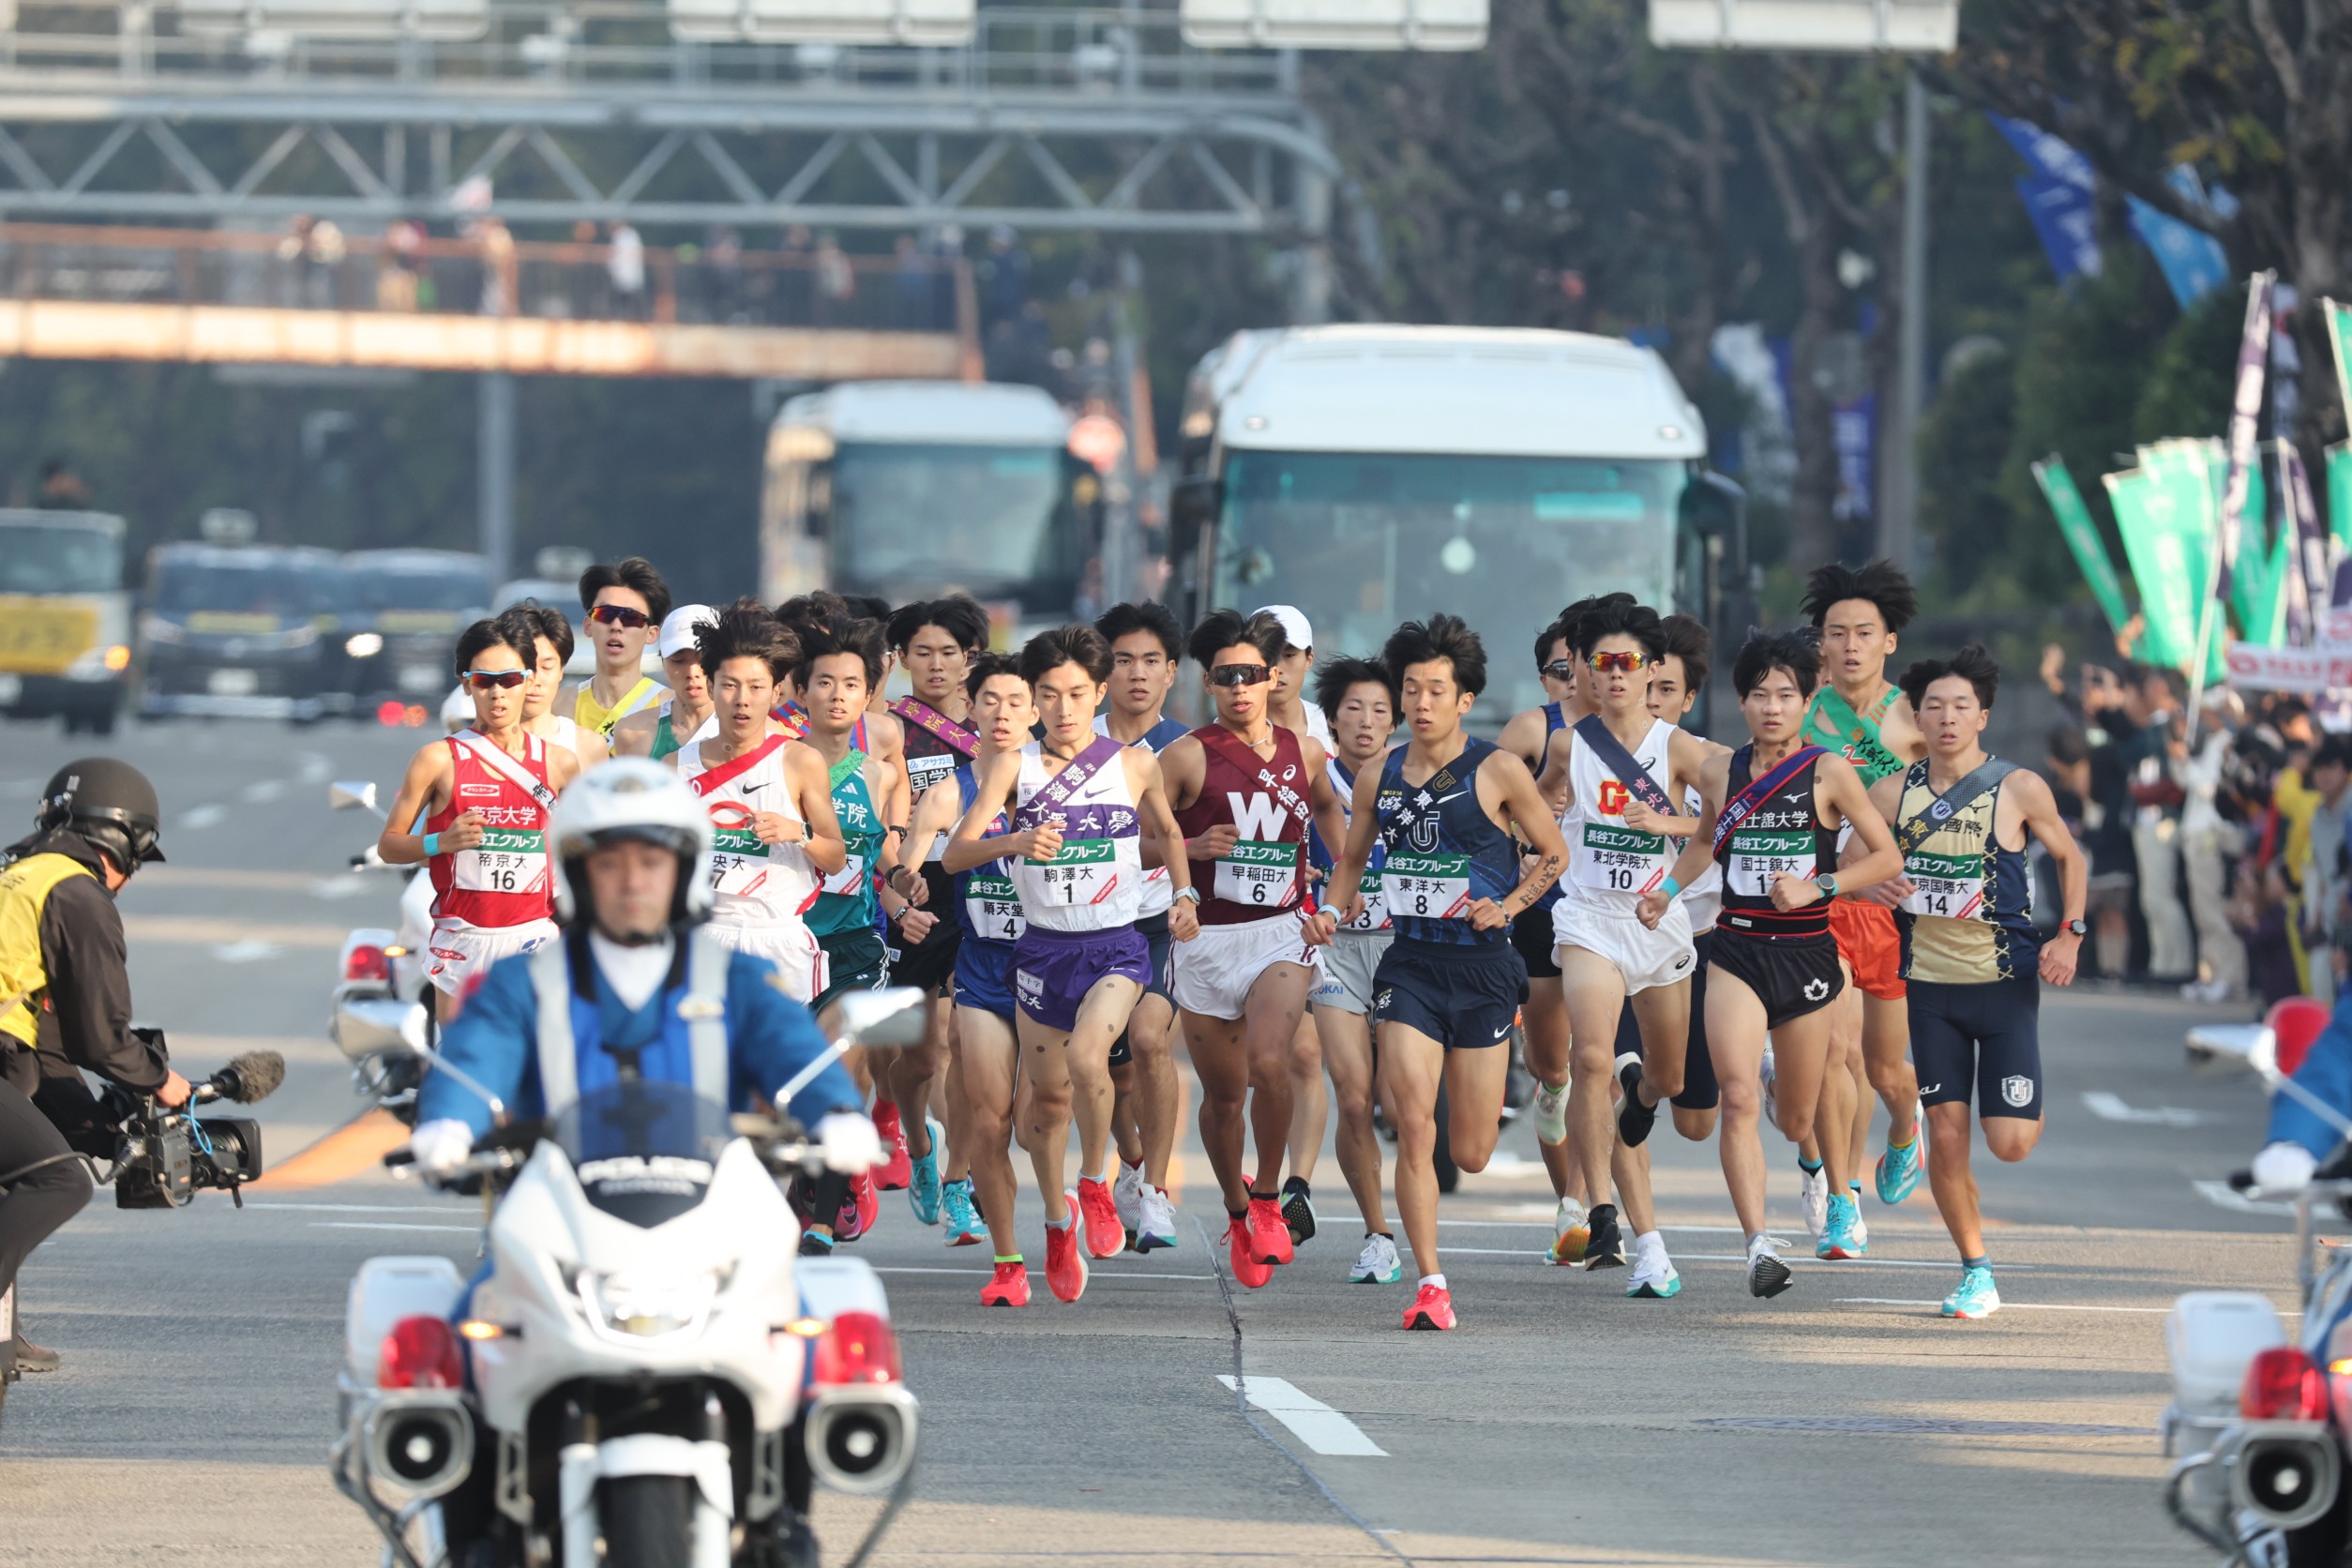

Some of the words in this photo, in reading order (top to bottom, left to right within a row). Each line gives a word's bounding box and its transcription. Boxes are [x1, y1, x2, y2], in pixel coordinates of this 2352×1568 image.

[890, 698, 981, 758] 學院大學
[921, 756, 954, 767] アサガミ
[910, 768, 955, 792] 国学
[1598, 780, 1630, 816] G
[1227, 792, 1289, 841] W
[1587, 829, 1662, 850] 長谷工グループ
[1732, 836, 1812, 851] 長谷工グループ
[478, 852, 527, 869] 帝京大
[1229, 844, 1296, 863] 谷工グループ
[1593, 850, 1651, 870] 東北学院大
[1044, 866, 1093, 882] 駒澤大
[1231, 866, 1288, 883] 早稲田大
[1385, 856, 1465, 873] 長谷工グループ
[490, 869, 516, 890] 16
[1399, 878, 1446, 894] 東洋大
[1608, 867, 1633, 890] 10
[1063, 882, 1073, 904] 1
[1252, 882, 1266, 903] 6
[984, 901, 1025, 918] 順天堂
[1415, 895, 1428, 914] 8
[1925, 894, 1949, 915] 14
[1003, 918, 1018, 938] 4
[1315, 985, 1344, 995] KAI
